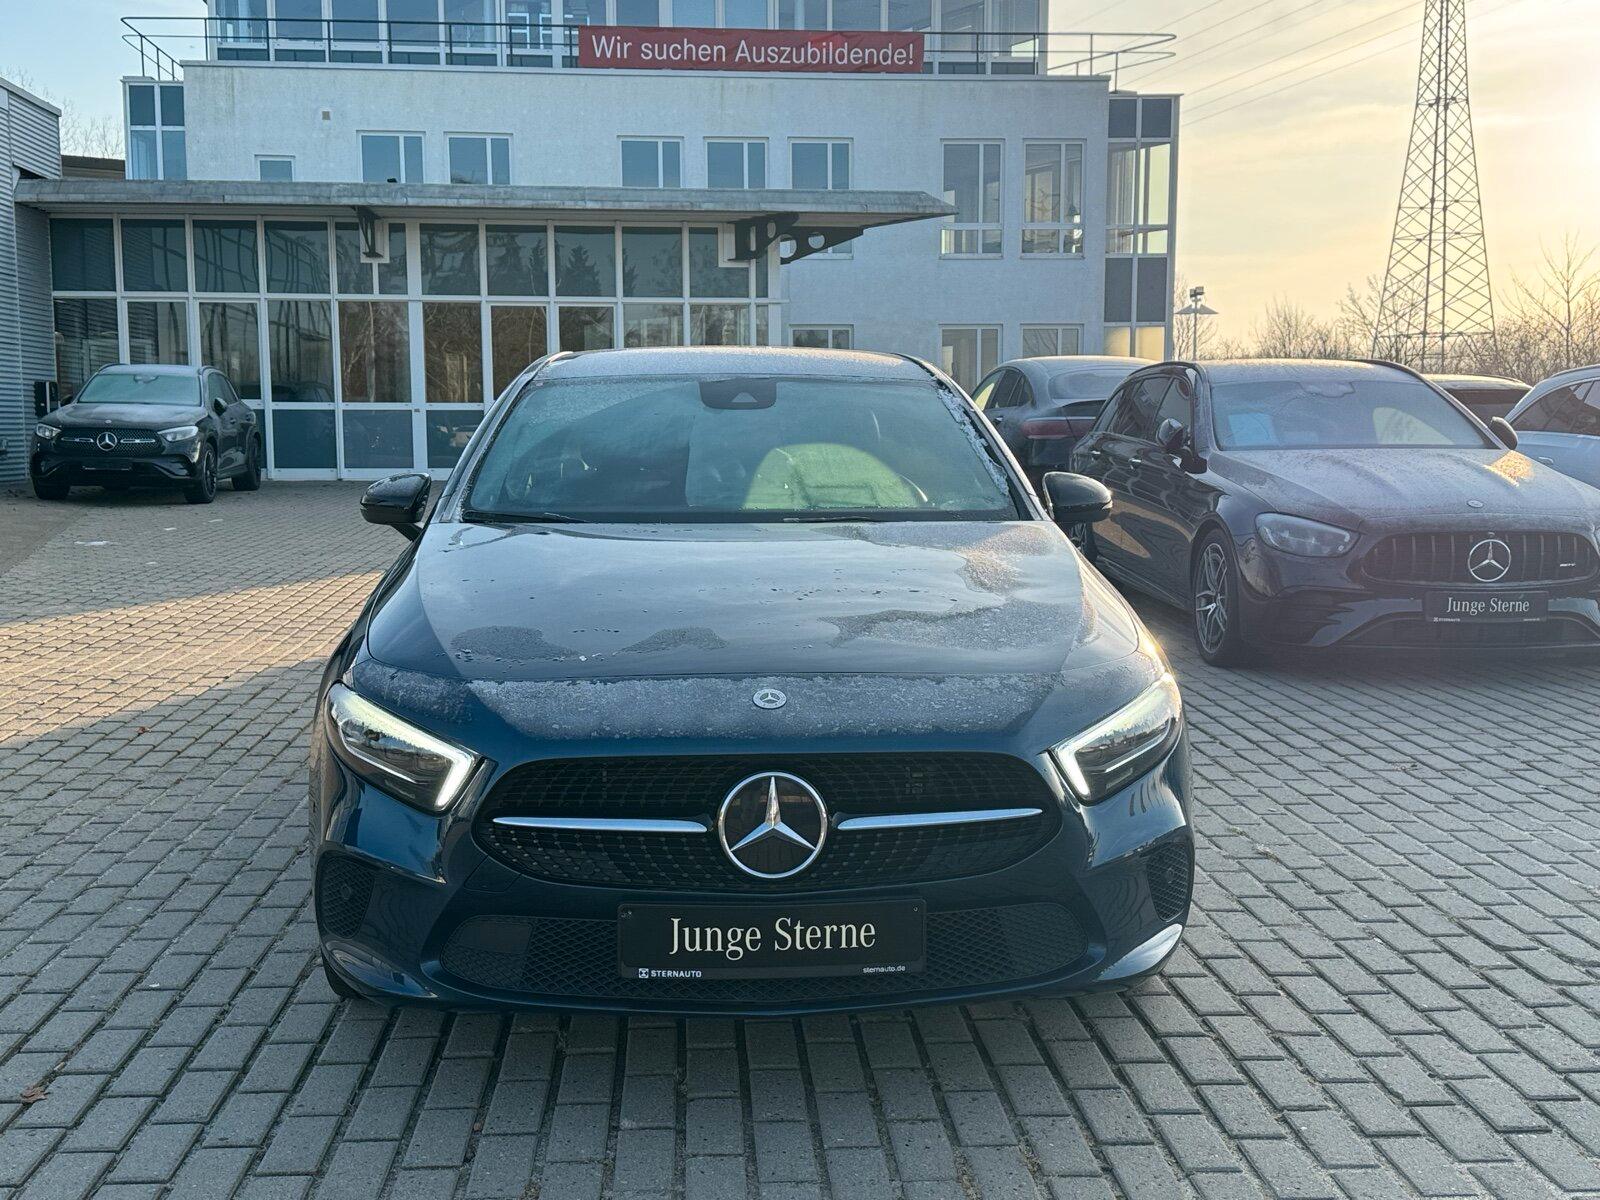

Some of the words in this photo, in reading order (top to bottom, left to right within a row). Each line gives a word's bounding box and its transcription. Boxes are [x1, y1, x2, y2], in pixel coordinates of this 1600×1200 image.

[591, 35, 633, 59] Wir
[640, 38, 726, 63] suchen
[734, 39, 914, 65] Auszubildende!
[1446, 597, 1486, 616] Junge
[1489, 597, 1530, 613] Sterne
[669, 917, 762, 961] Junge
[774, 917, 876, 952] Sterne
[650, 969, 702, 978] STERNAUTO
[862, 964, 906, 974] sternauto.de
